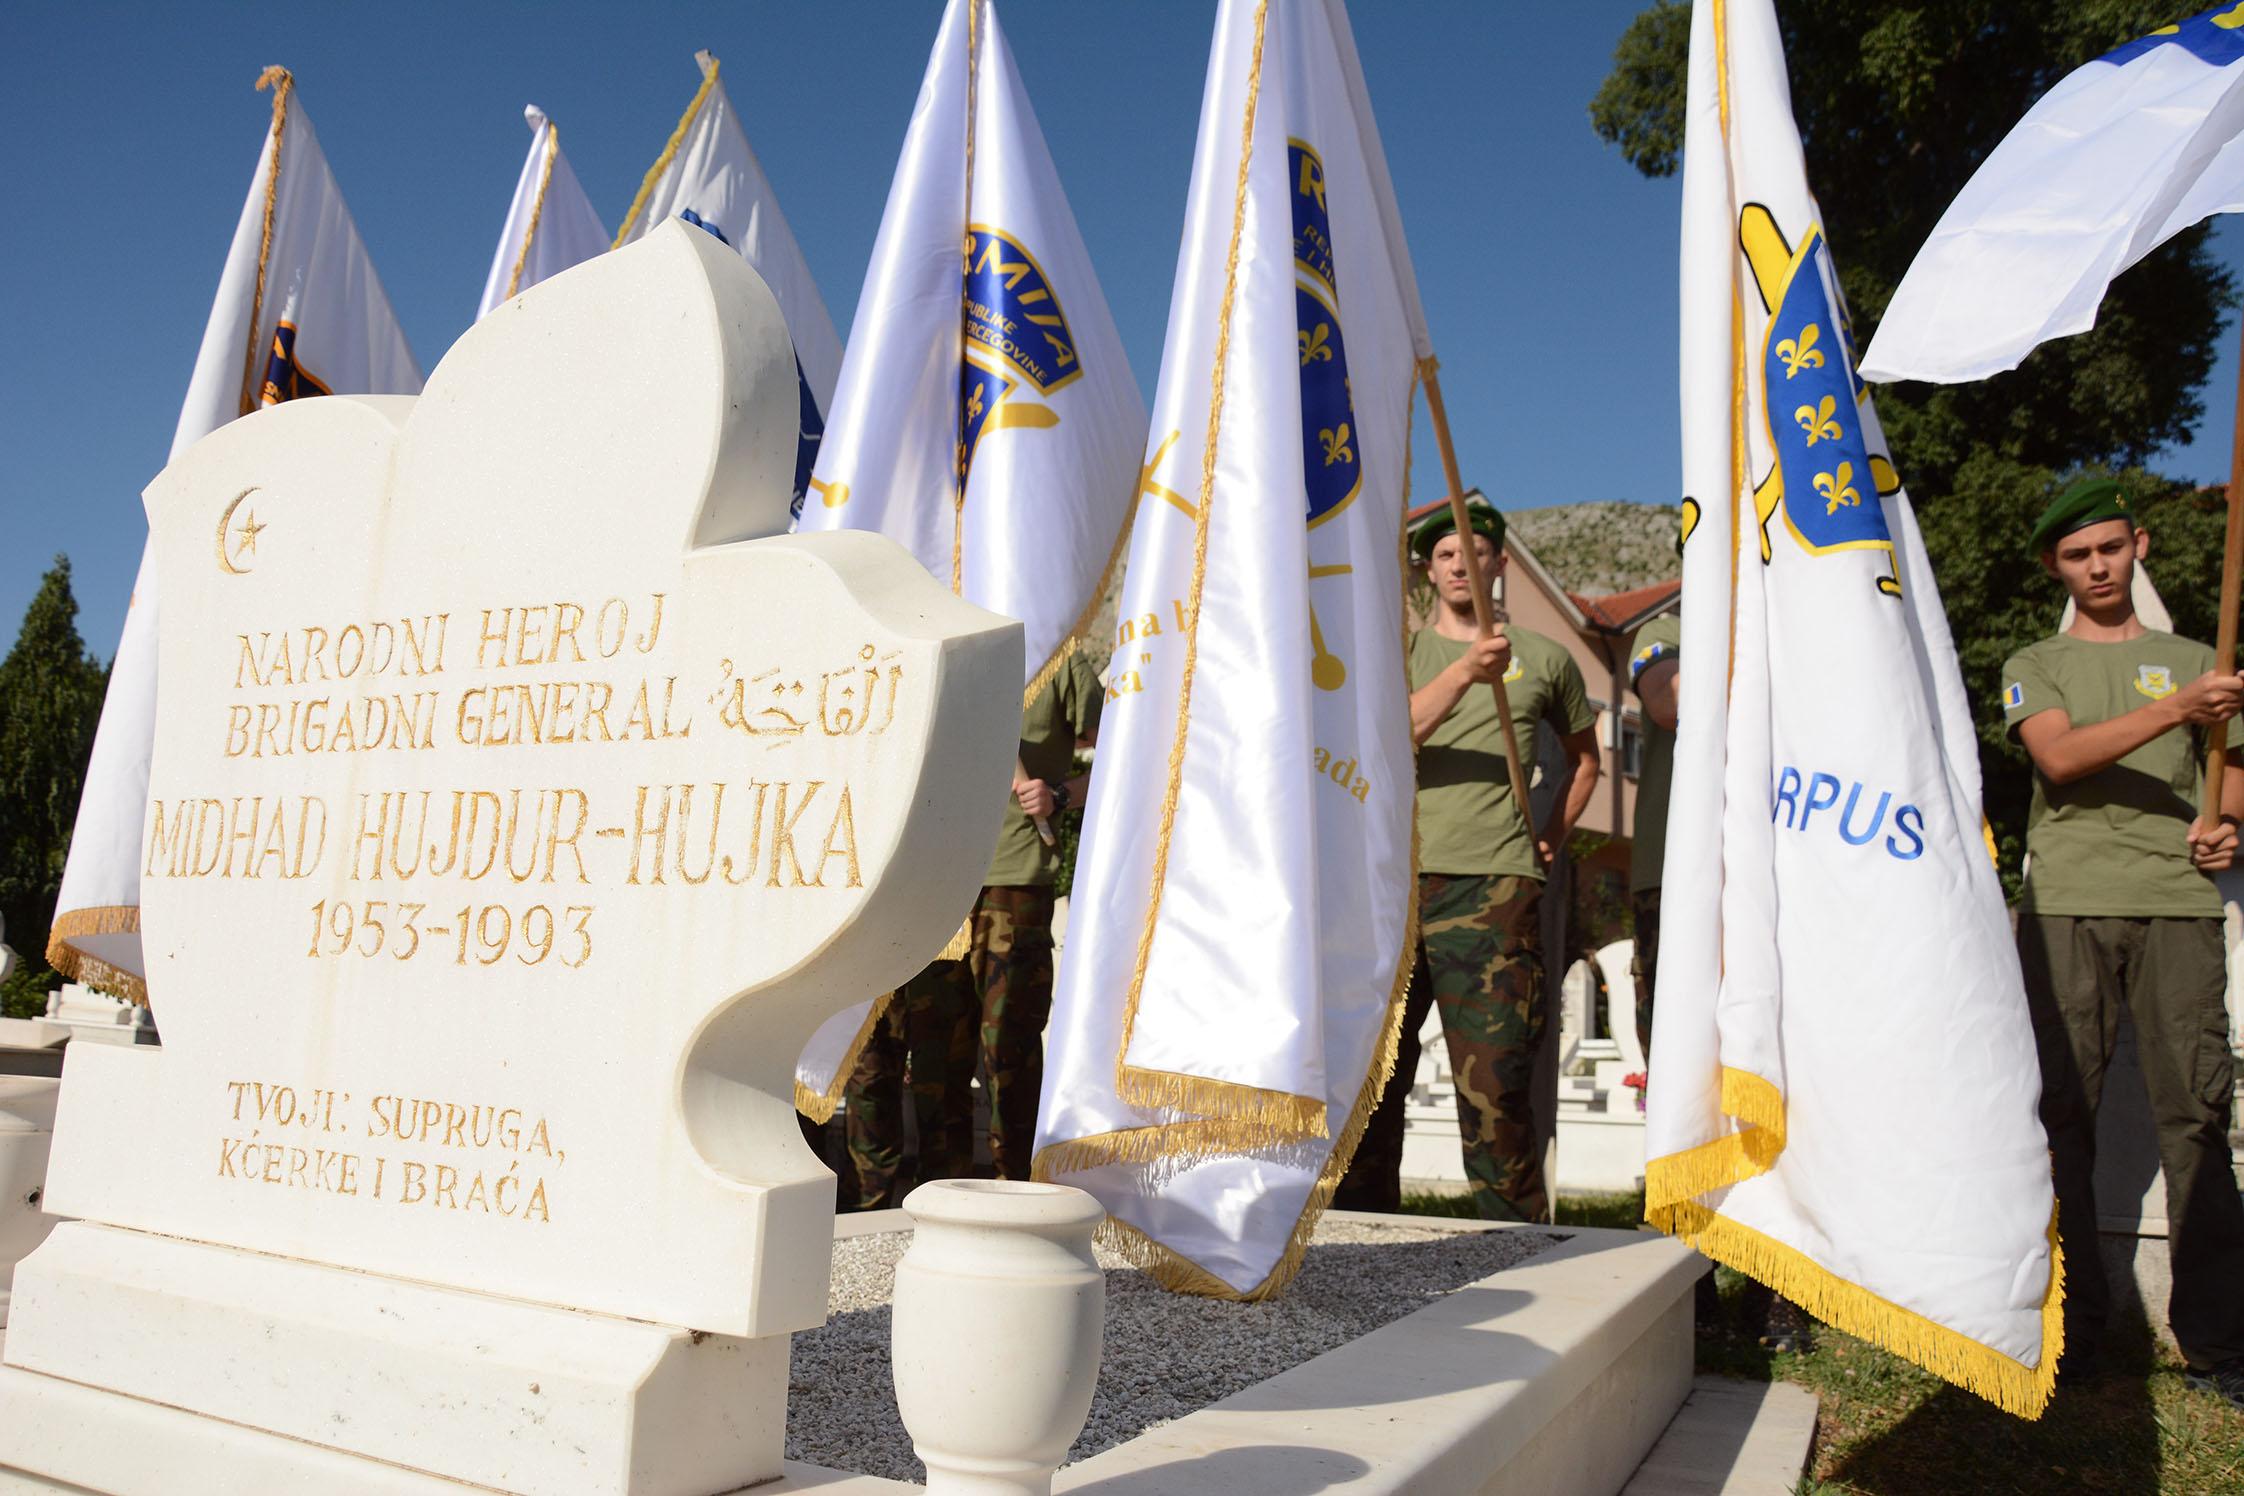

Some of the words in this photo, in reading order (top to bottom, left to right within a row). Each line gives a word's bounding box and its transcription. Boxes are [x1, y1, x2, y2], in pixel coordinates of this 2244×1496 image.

[233, 613, 450, 689] NARODNI
[476, 593, 668, 670] HEROJ
[224, 690, 440, 758] BRIGADNI
[456, 675, 693, 749] GENERAL
[145, 795, 328, 880] MIDHAD
[350, 776, 865, 888] HUJDUR-HUJKA
[1772, 766, 1924, 861] RPUS
[307, 898, 597, 970] 1953-1993
[217, 1129, 360, 1196] KĆERKE
[373, 1156, 386, 1200] I
[399, 1159, 550, 1224] BRAĆA
[368, 1094, 565, 1169] SUPRUGA,
